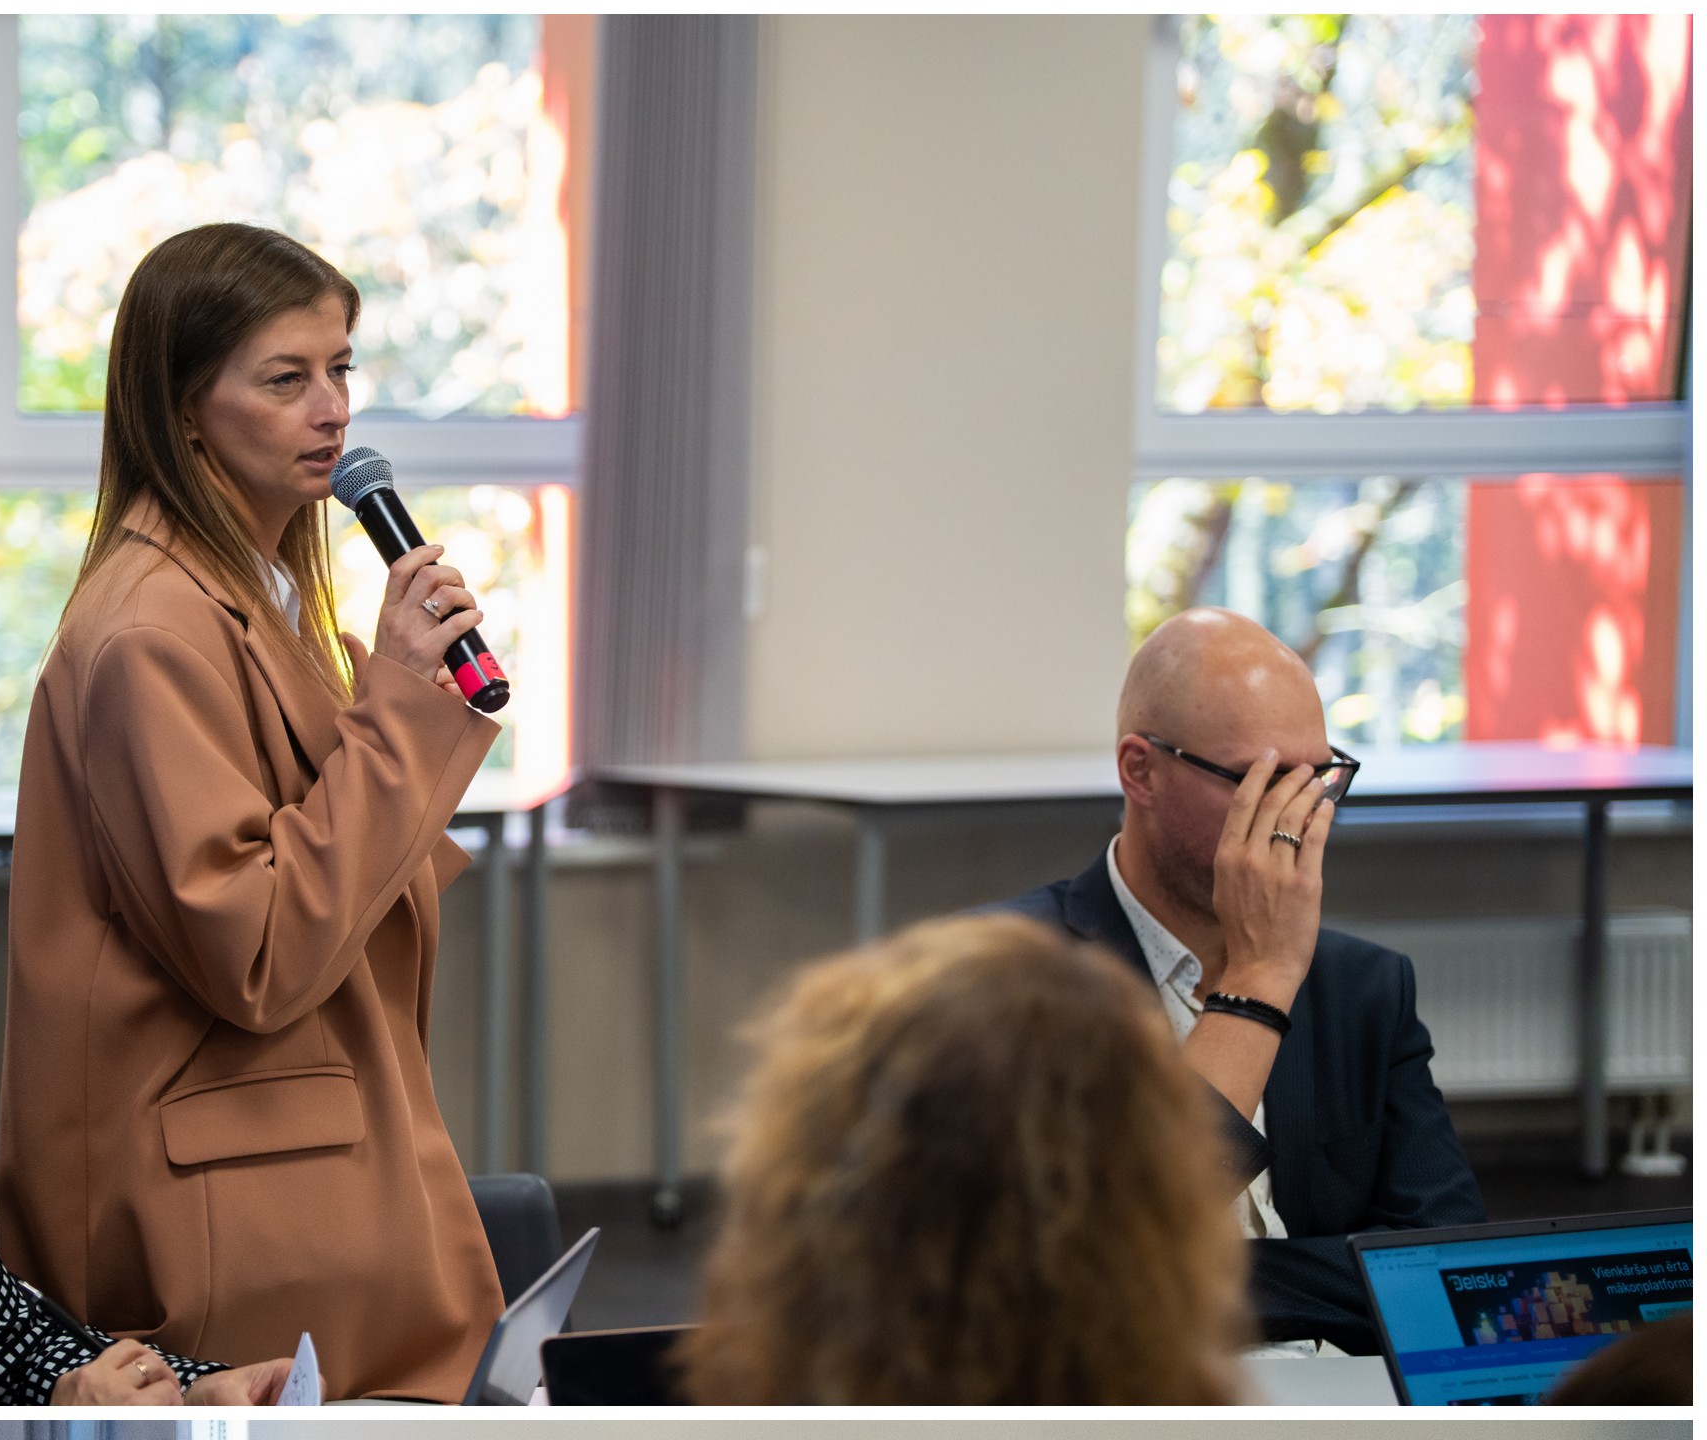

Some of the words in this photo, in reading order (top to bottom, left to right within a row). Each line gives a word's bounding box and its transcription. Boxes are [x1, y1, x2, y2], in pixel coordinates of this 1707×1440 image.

[1592, 1263, 1648, 1279] Vienkārša
[1650, 1264, 1664, 1273] un
[1666, 1261, 1689, 1271] ērta
